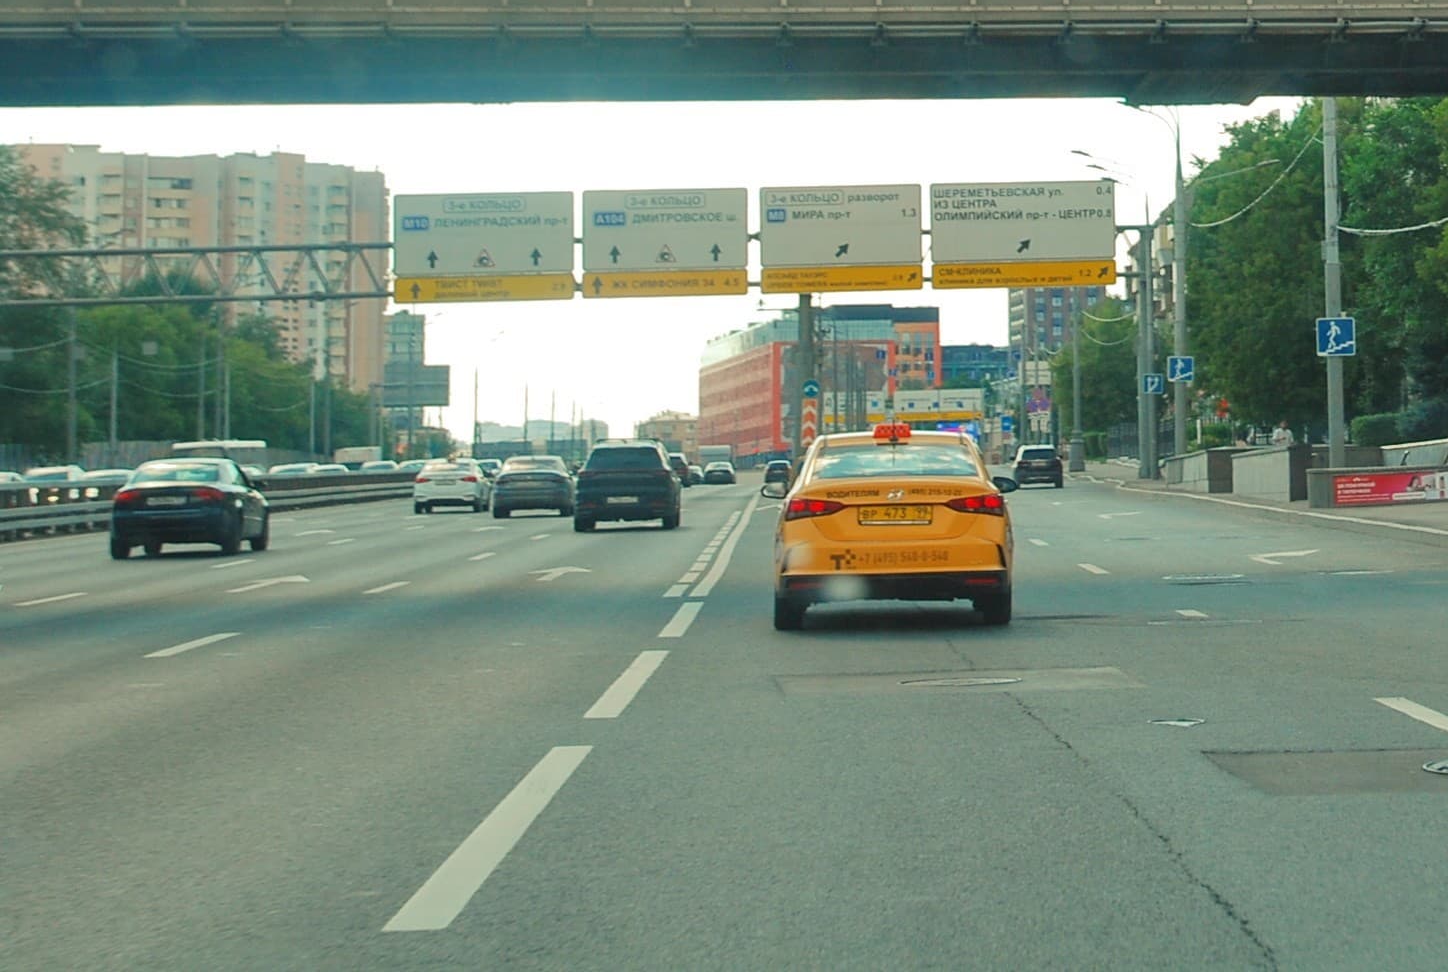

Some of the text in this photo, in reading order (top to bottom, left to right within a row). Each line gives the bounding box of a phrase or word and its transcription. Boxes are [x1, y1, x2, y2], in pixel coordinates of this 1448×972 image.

[933, 186, 1111, 199] ШЕРЕМЕТЬЕВСКАЯ ул. 0.4
[469, 198, 522, 211] КОЛЬЦО
[650, 195, 701, 207] КОЛЬЦО
[790, 194, 839, 205] КОЛЬЦО
[848, 194, 900, 204] разворот
[934, 199, 997, 210] ИЗ ЦЕНТРА
[632, 212, 723, 225] ДМИТРОВСКОЕ
[792, 211, 825, 220] МИРА
[828, 211, 851, 221] пр-т
[901, 208, 917, 218] 1.3
[934, 209, 1023, 221] ОЛИМПИЙСКИЙ
[1026, 211, 1049, 221] пр-т
[1058, 209, 1096, 220] ЦЕНТР
[434, 215, 542, 229] ЛЕНИНГРАДСКИЙ
[544, 216, 568, 227] пр-т
[883, 507, 907, 520] 473
